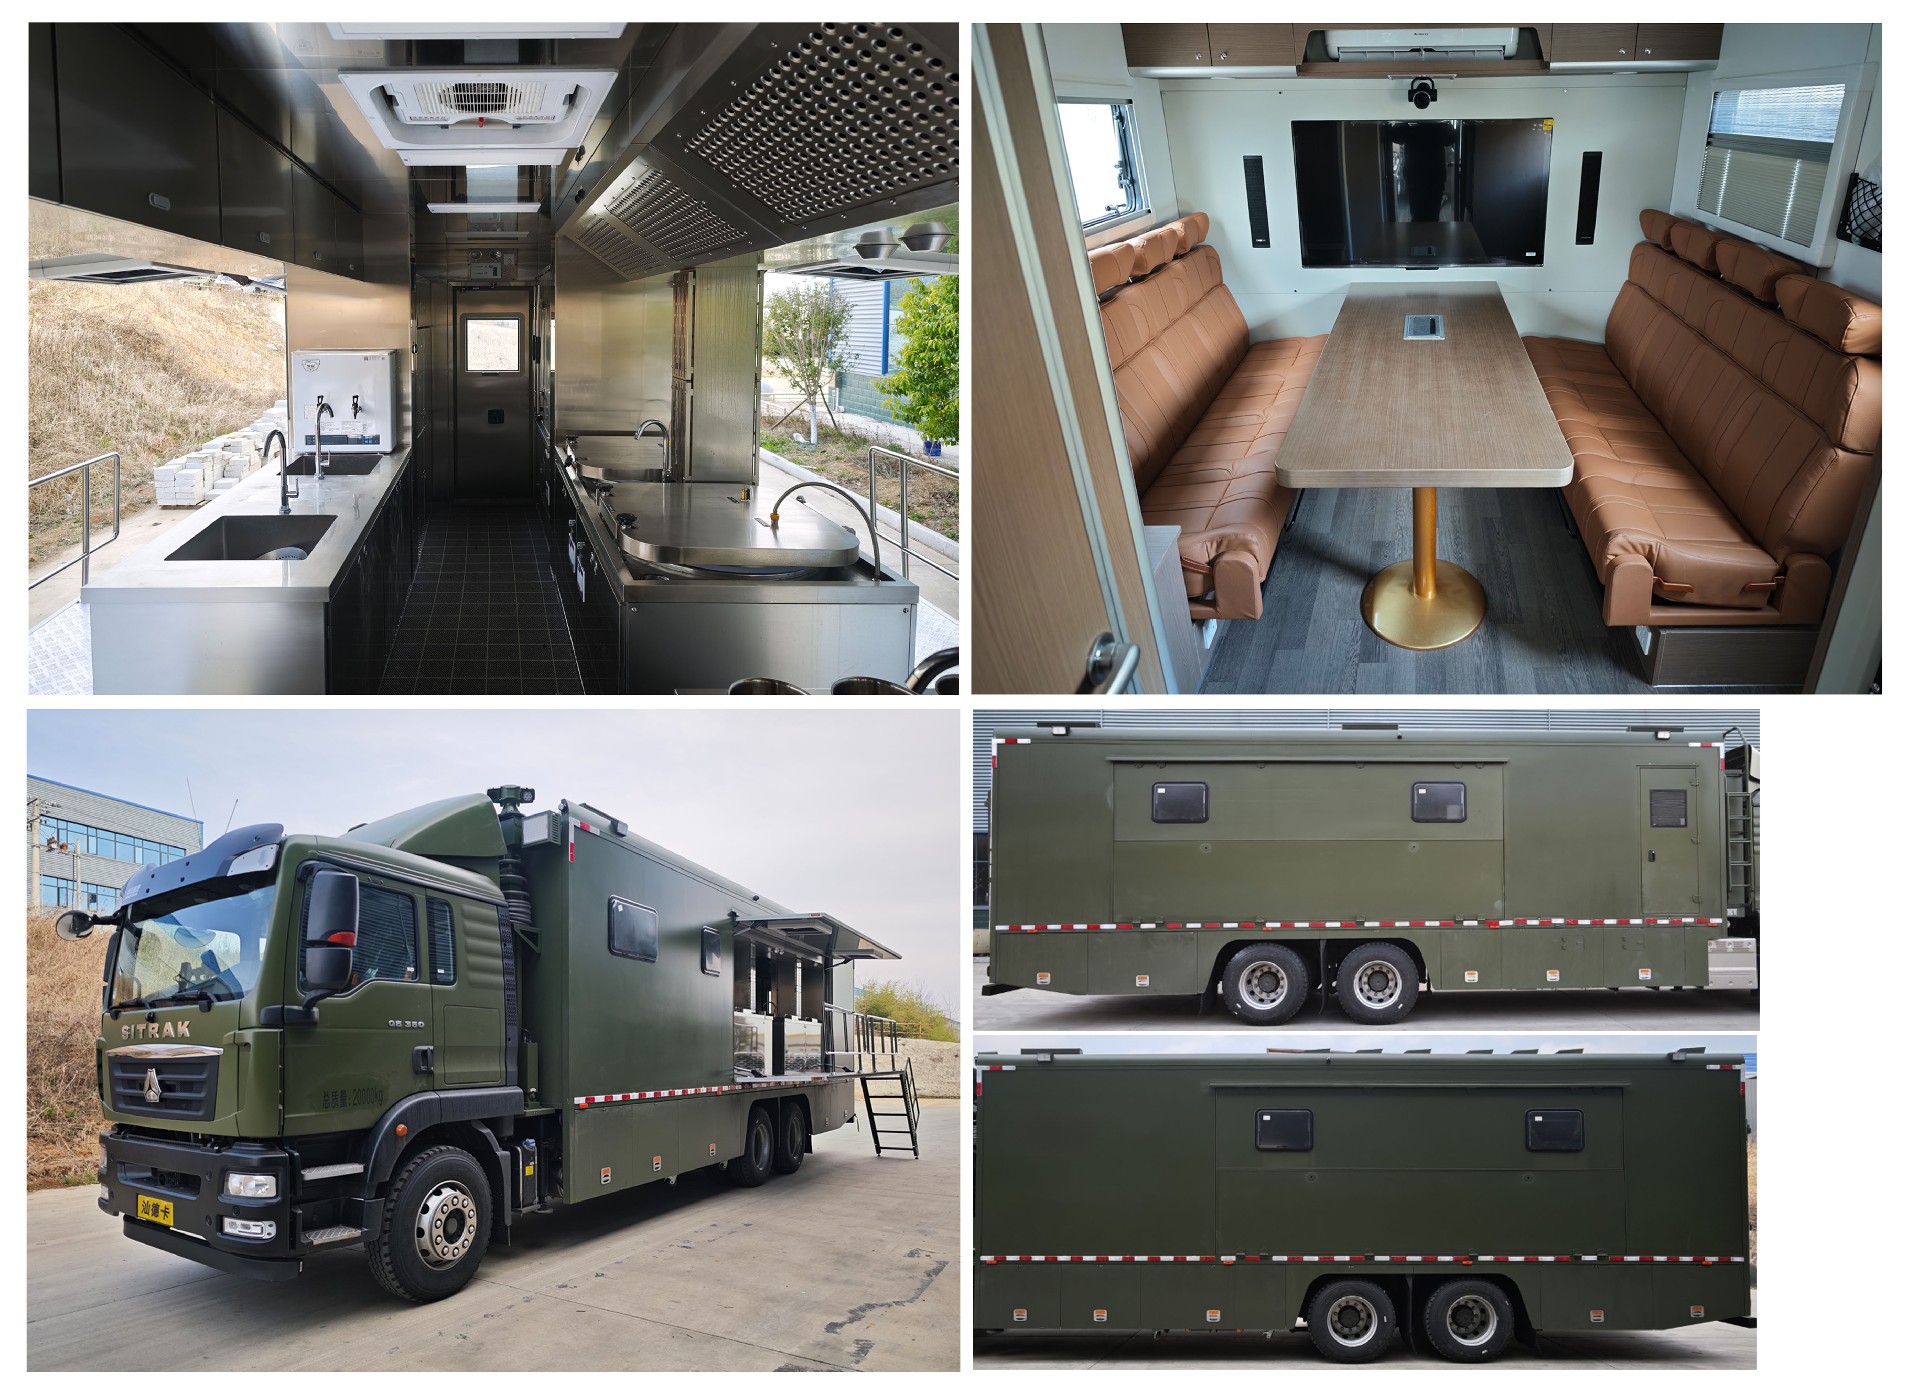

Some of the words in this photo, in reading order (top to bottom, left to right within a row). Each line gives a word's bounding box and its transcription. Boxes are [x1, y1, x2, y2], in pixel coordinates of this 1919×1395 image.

[121, 1021, 190, 1040] SITRAK
[141, 1200, 170, 1220] 汕德卡
